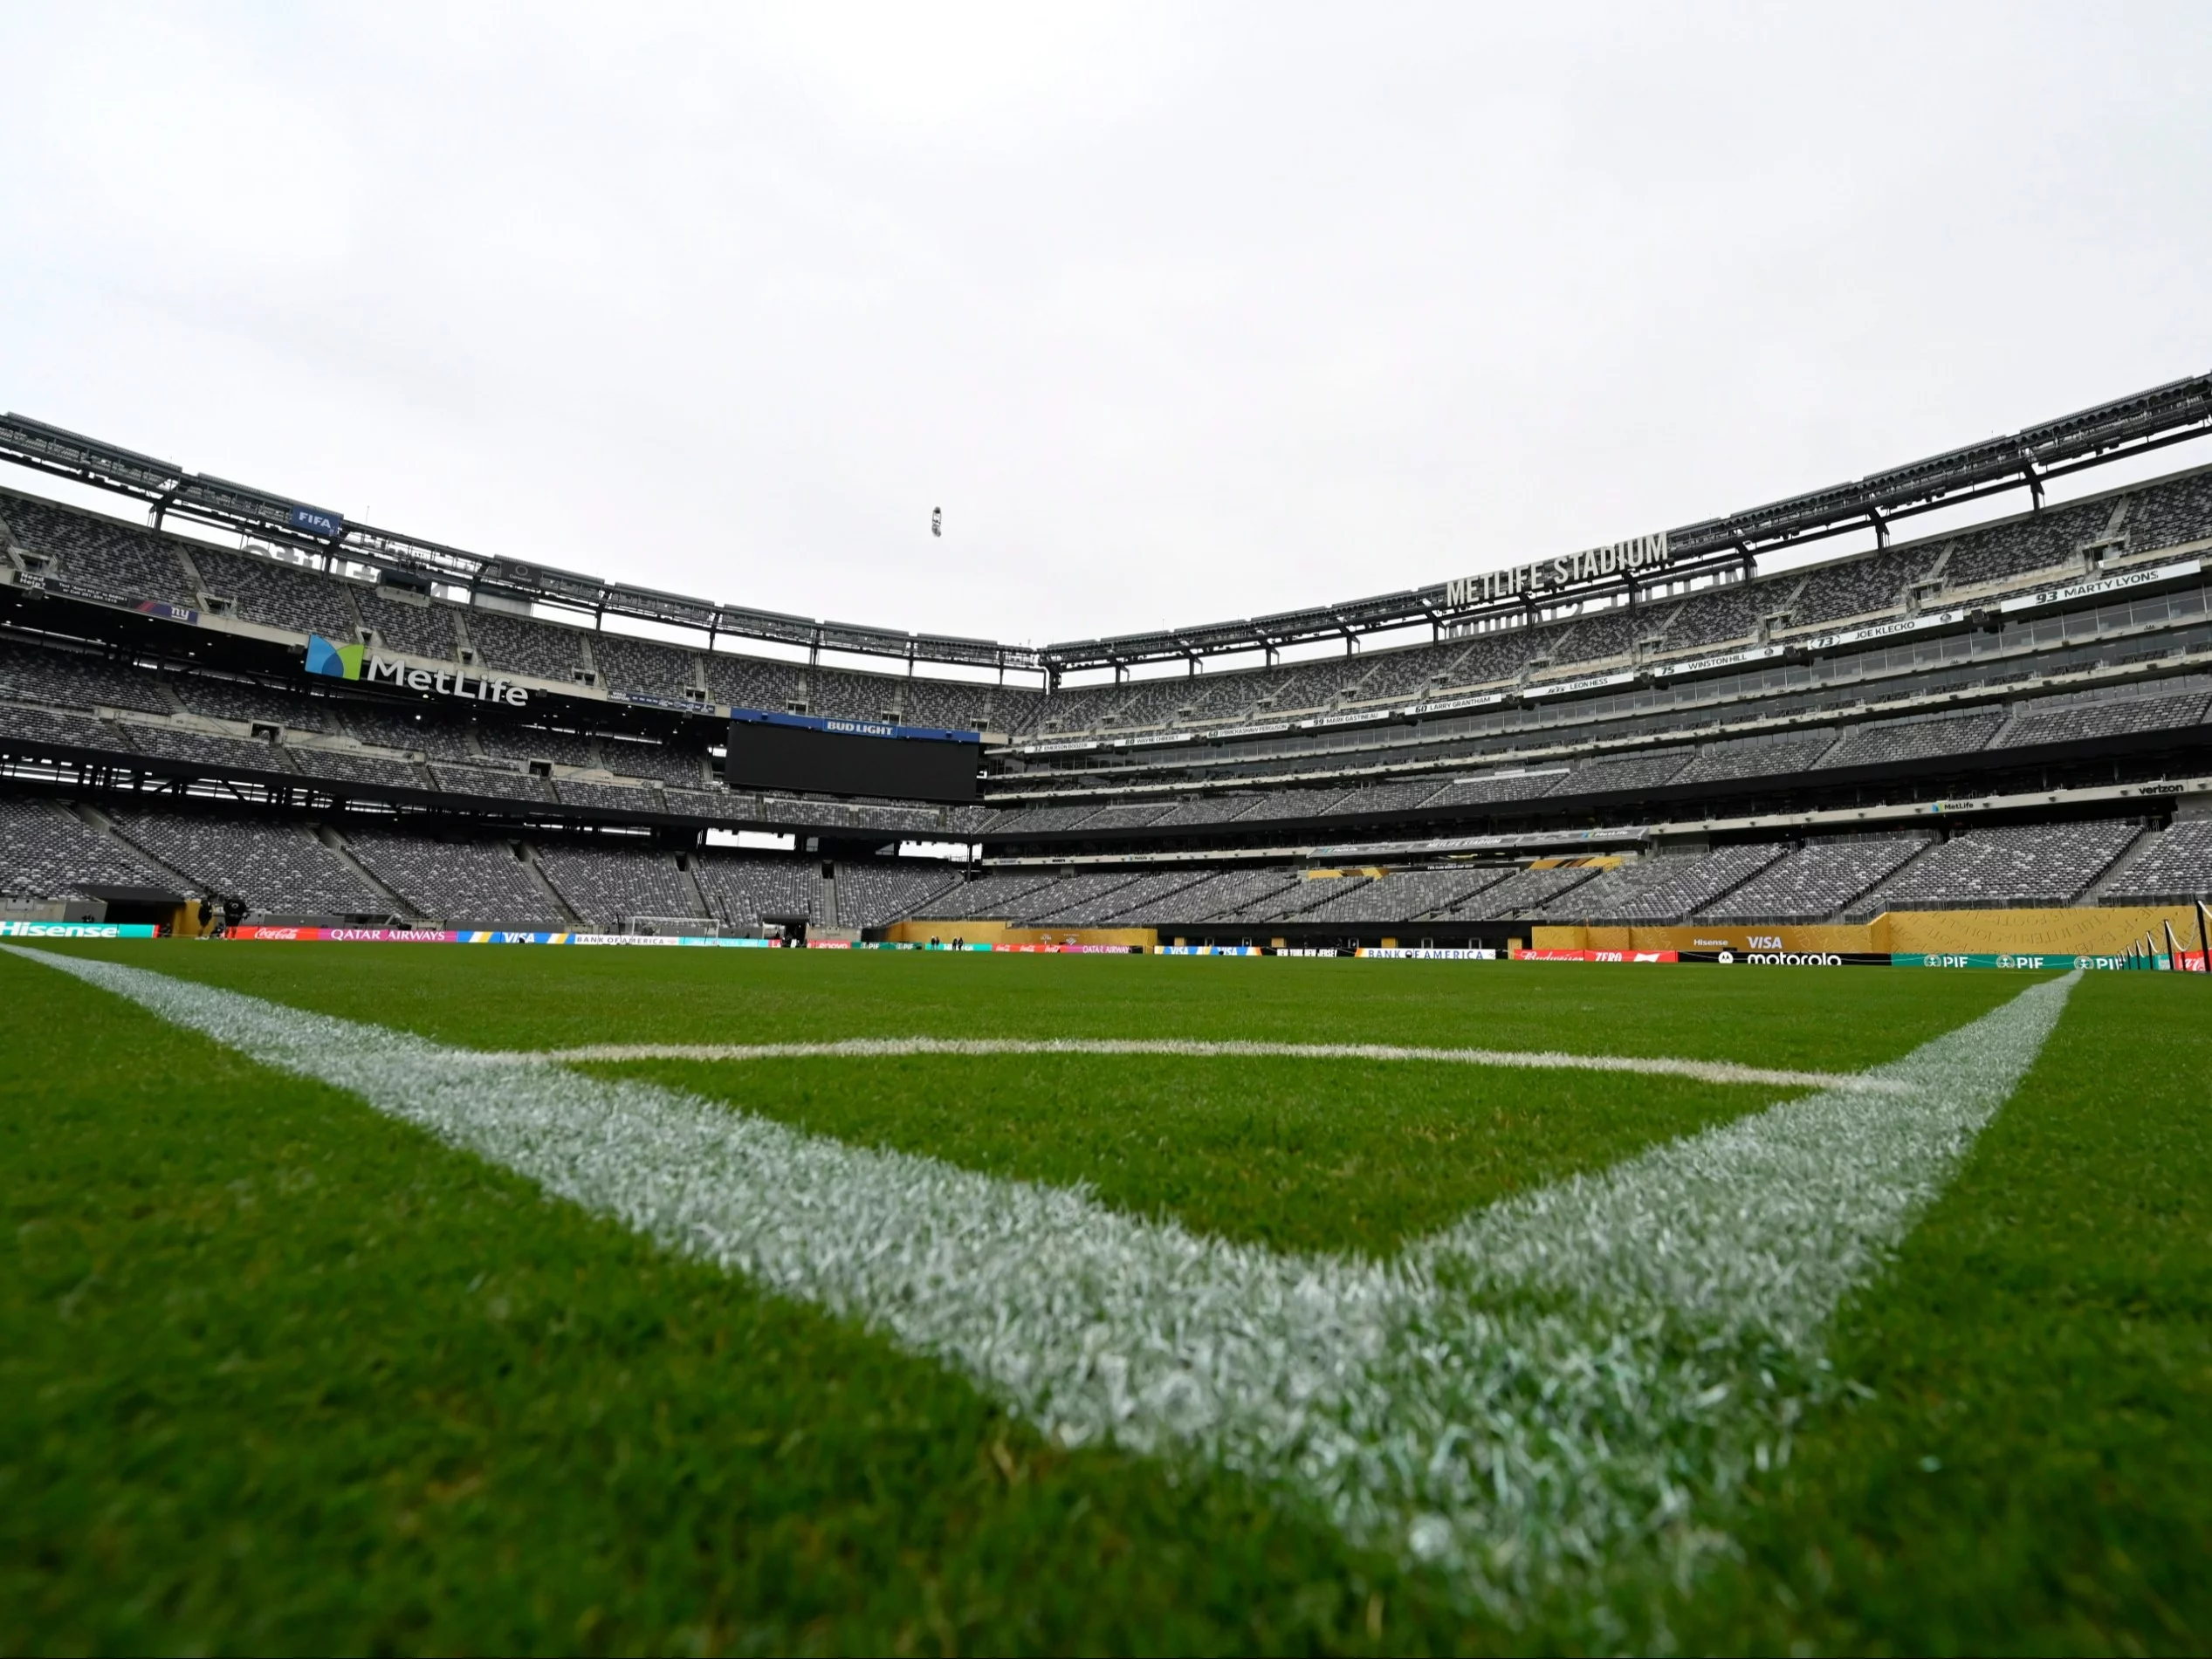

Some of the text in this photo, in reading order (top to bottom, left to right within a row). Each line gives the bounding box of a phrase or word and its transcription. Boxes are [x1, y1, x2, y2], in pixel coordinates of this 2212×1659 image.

[299, 511, 331, 529] FIFA
[1446, 531, 1668, 607] METLIFE STADIUM
[19, 578, 46, 588] Help?
[21, 572, 45, 582] Need
[2036, 570, 2159, 604] 93 MARTY LYONS
[1817, 620, 1915, 648] 73 JOE KLECKO
[1661, 654, 1748, 675] 75 WINSTON HILL
[367, 655, 529, 707] MetLife
[1570, 681, 1589, 690] LEON
[1589, 677, 1609, 687] HESS
[1414, 696, 1491, 714] 60 LARRY GRANTHAM
[1326, 716, 1343, 725] MARK
[1344, 712, 1378, 723] GASTINEAU
[827, 721, 893, 736] BUD LIGHT
[2138, 784, 2184, 795] verizon
[1944, 801, 1974, 811] MetLife
[0, 922, 118, 937] Hisense
[330, 929, 445, 941] QATAR AIRWAYS
[502, 932, 535, 943] VISA
[1747, 936, 1783, 949] VISA
[1216, 947, 1238, 956] VISA
[1317, 949, 1337, 957] JERSEY
[1368, 949, 1483, 959] BANK OF AMERICA
[1521, 950, 1584, 961] Budweiser
[1595, 952, 1623, 962] ZERO
[1747, 952, 1842, 965] motorola
[1943, 956, 1968, 968] PIF
[2017, 957, 2044, 969] PIF
